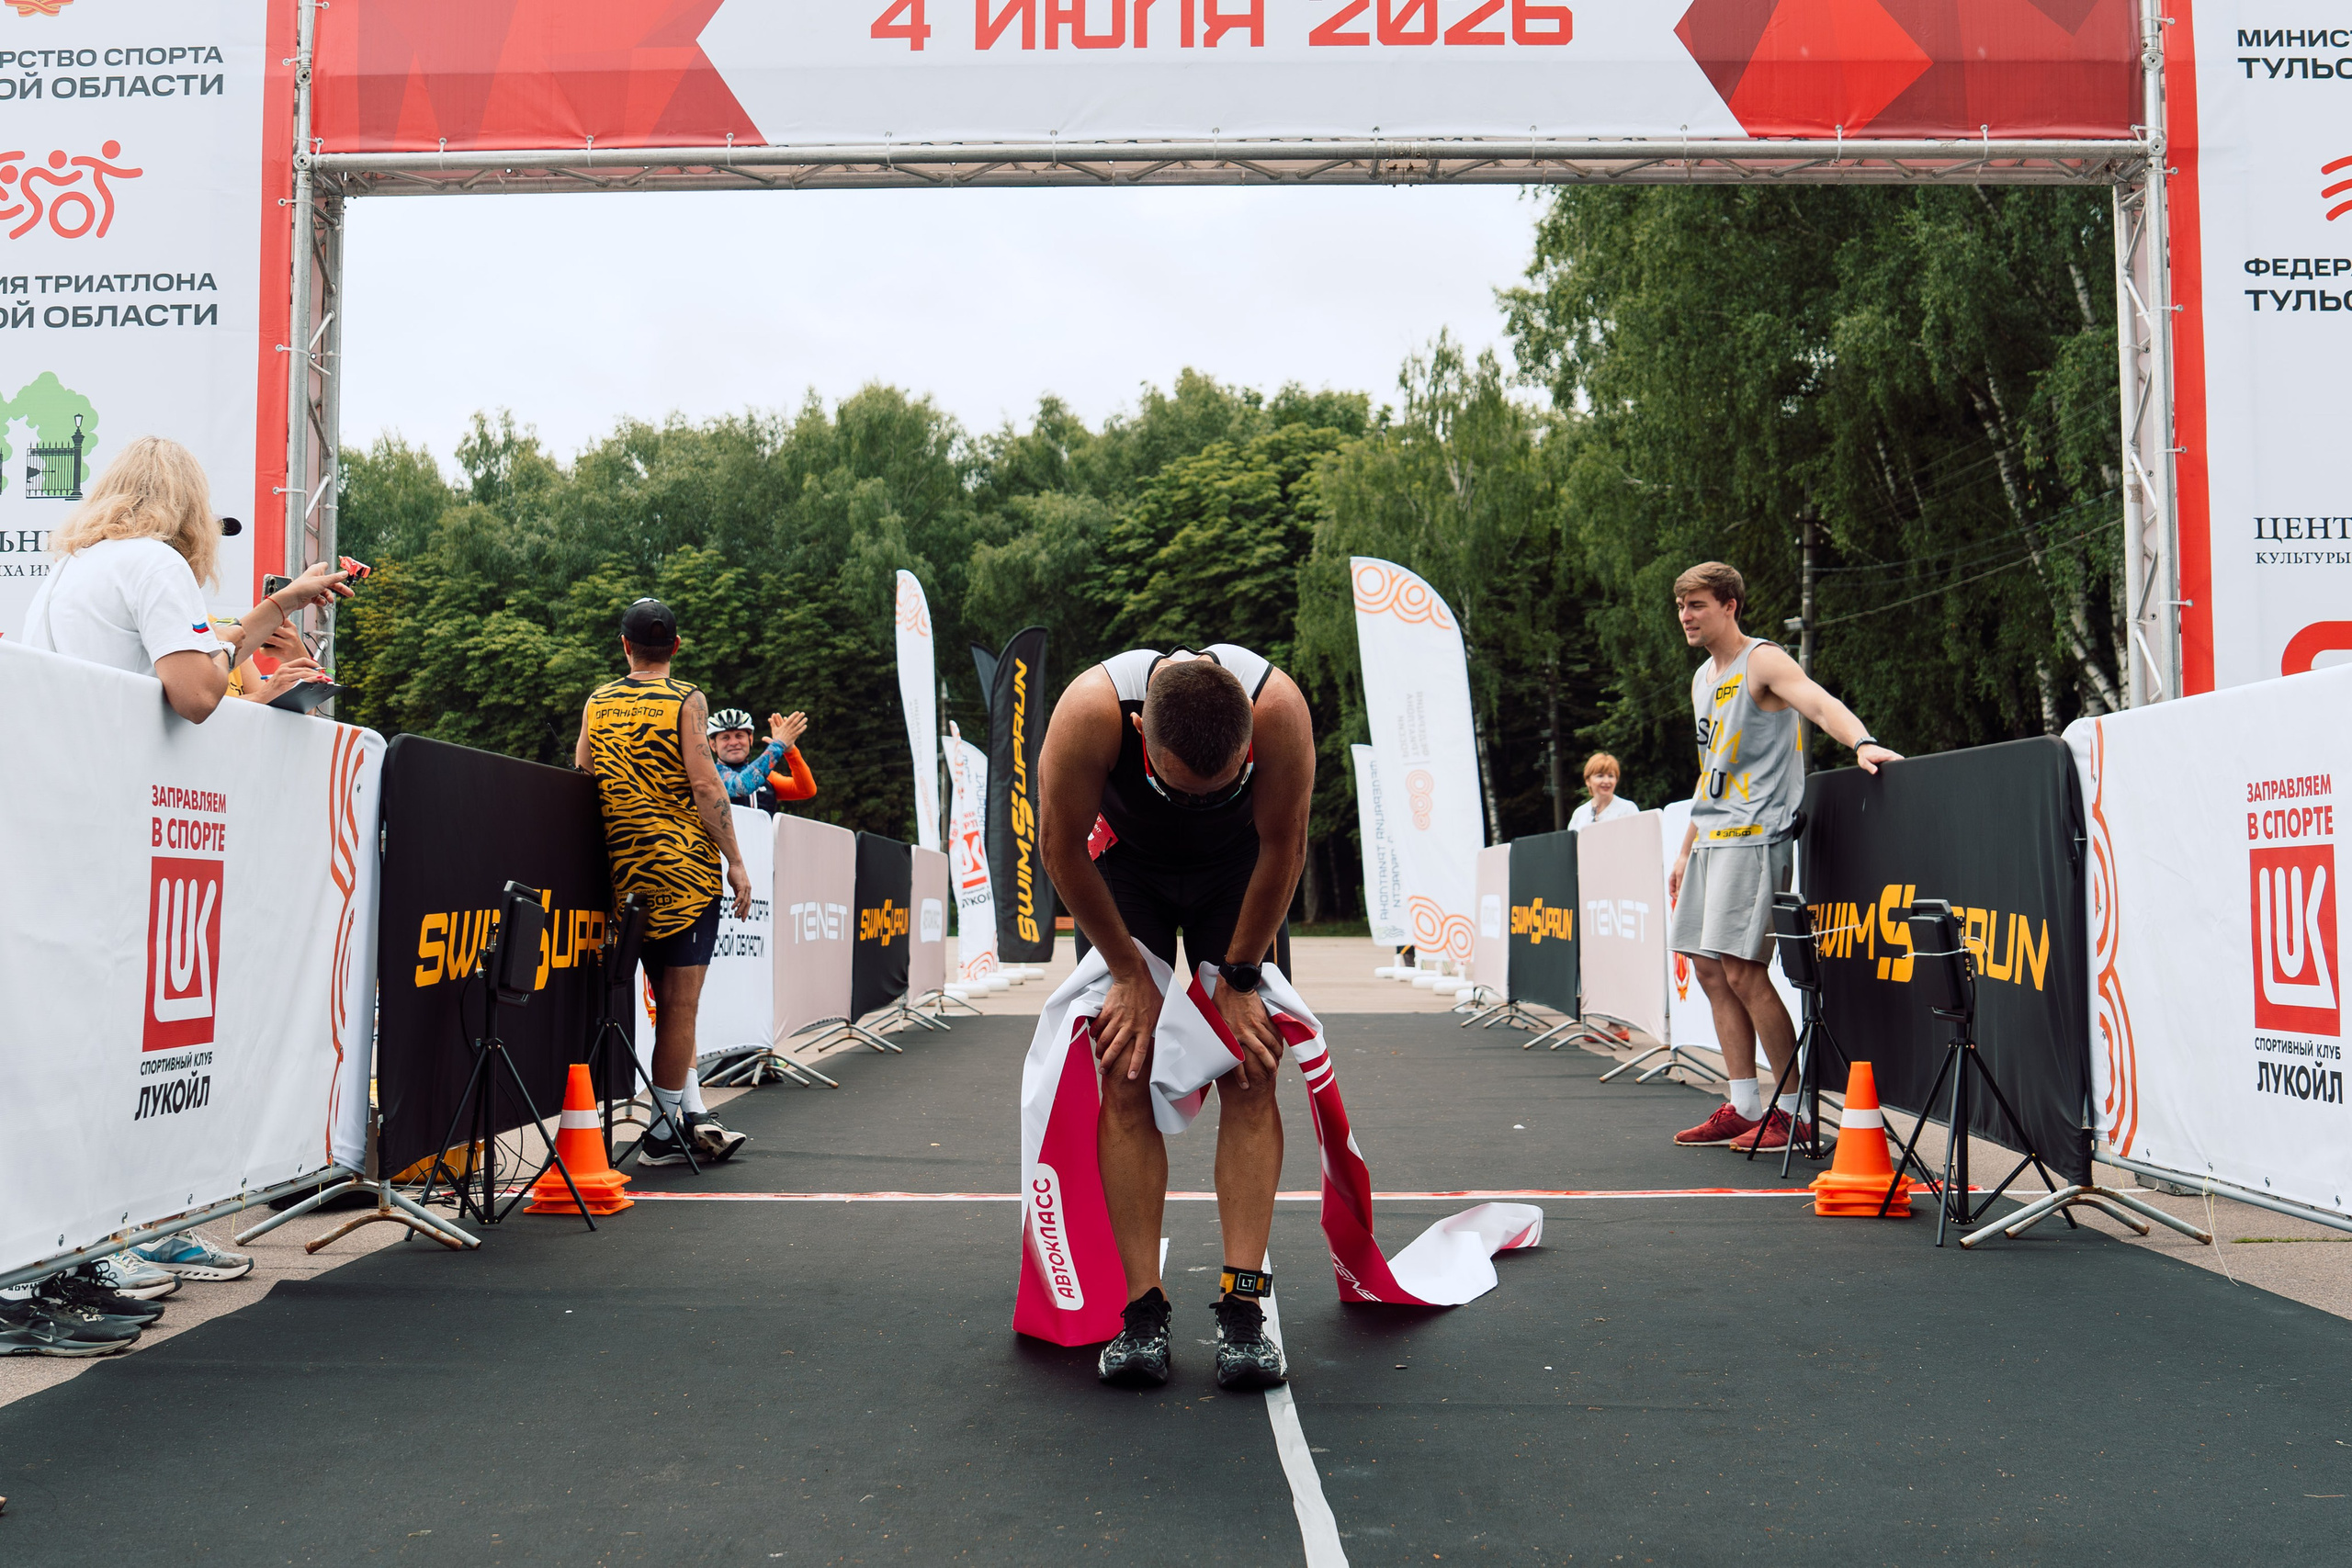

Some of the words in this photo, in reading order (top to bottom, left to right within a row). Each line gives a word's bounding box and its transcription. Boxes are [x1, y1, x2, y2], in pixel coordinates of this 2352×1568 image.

[871, 0, 931, 51] 4
[975, 0, 1264, 51] ИЮЛЯ
[1309, 0, 1573, 47] 2026
[2238, 29, 2352, 48] МИНИС
[104, 46, 224, 67] СПОРТА
[51, 73, 224, 99] ОБЛАСТИ
[2245, 258, 2352, 280] ФЕДЕР
[35, 273, 218, 294] ТРИАТЛОНА
[43, 303, 218, 328] ОБЛАСТИ
[2256, 551, 2352, 565] КУЛЬТУРЫ
[1716, 685, 1739, 700] ОРГ
[596, 706, 664, 719] ОРГАНИЗАТОР
[152, 784, 227, 814] ЗАПРАВЛЯЕМ
[2246, 773, 2332, 803] ЗАПРАВЛЯЕМ
[152, 817, 164, 848] В
[166, 818, 225, 852] СПОРТЕ
[2247, 812, 2259, 840] В
[2263, 805, 2334, 839] СПОРТЕ
[789, 901, 848, 944] TENET
[1587, 899, 1649, 943] TENET
[2255, 1036, 2313, 1056] СПОРТИВНЫЙ
[2316, 1042, 2341, 1060] КЛУБ
[140, 1052, 192, 1077] СПОРТИВНЫЙ
[194, 1051, 213, 1067] КЛУБ
[2257, 1061, 2343, 1104] ЛУКОЙЛ
[133, 1070, 211, 1122] ЛУКОЙЛ
[1033, 1178, 1075, 1299] АВТОКЛАСС
[1241, 1278, 1252, 1288] LT
